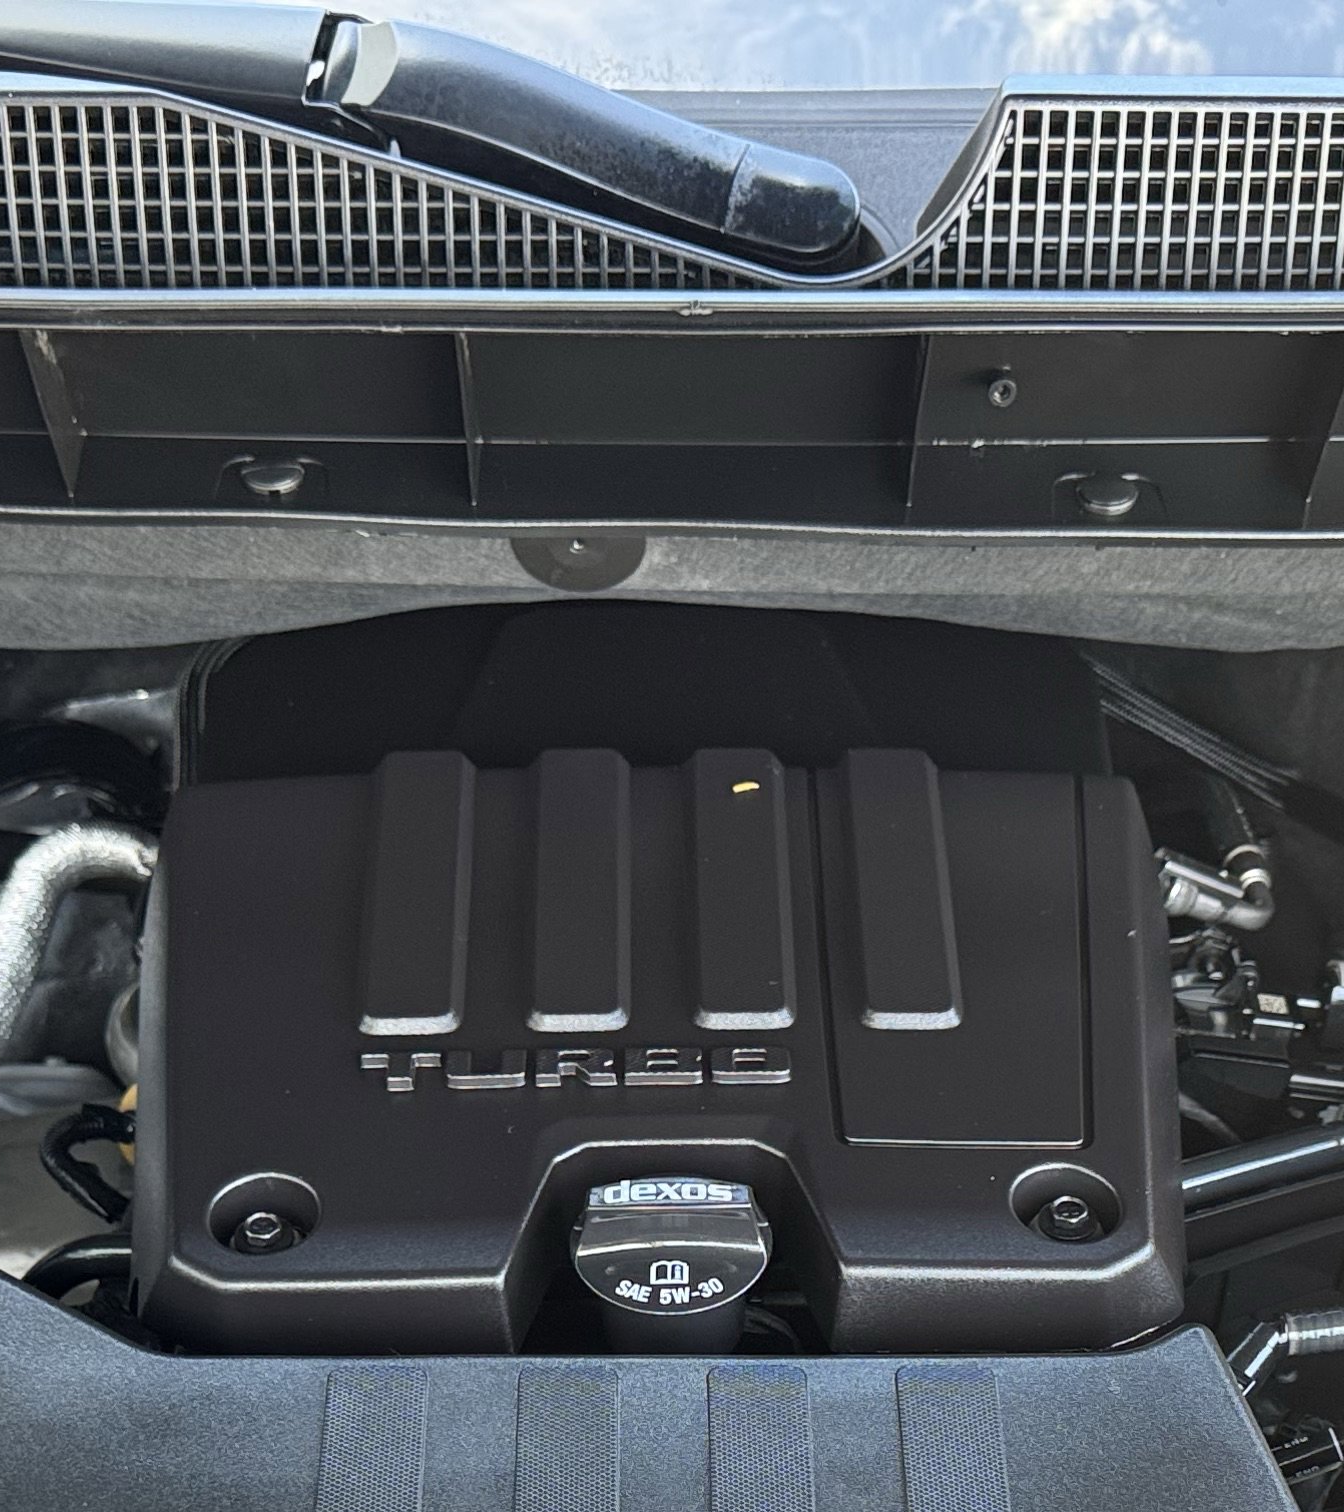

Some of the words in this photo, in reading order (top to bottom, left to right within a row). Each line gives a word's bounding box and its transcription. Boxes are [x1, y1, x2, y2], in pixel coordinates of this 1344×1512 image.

[359, 1047, 792, 1092] TURBO
[603, 1180, 733, 1204] dexos
[614, 1279, 653, 1304] SAE
[659, 1277, 724, 1305] 5W-30
